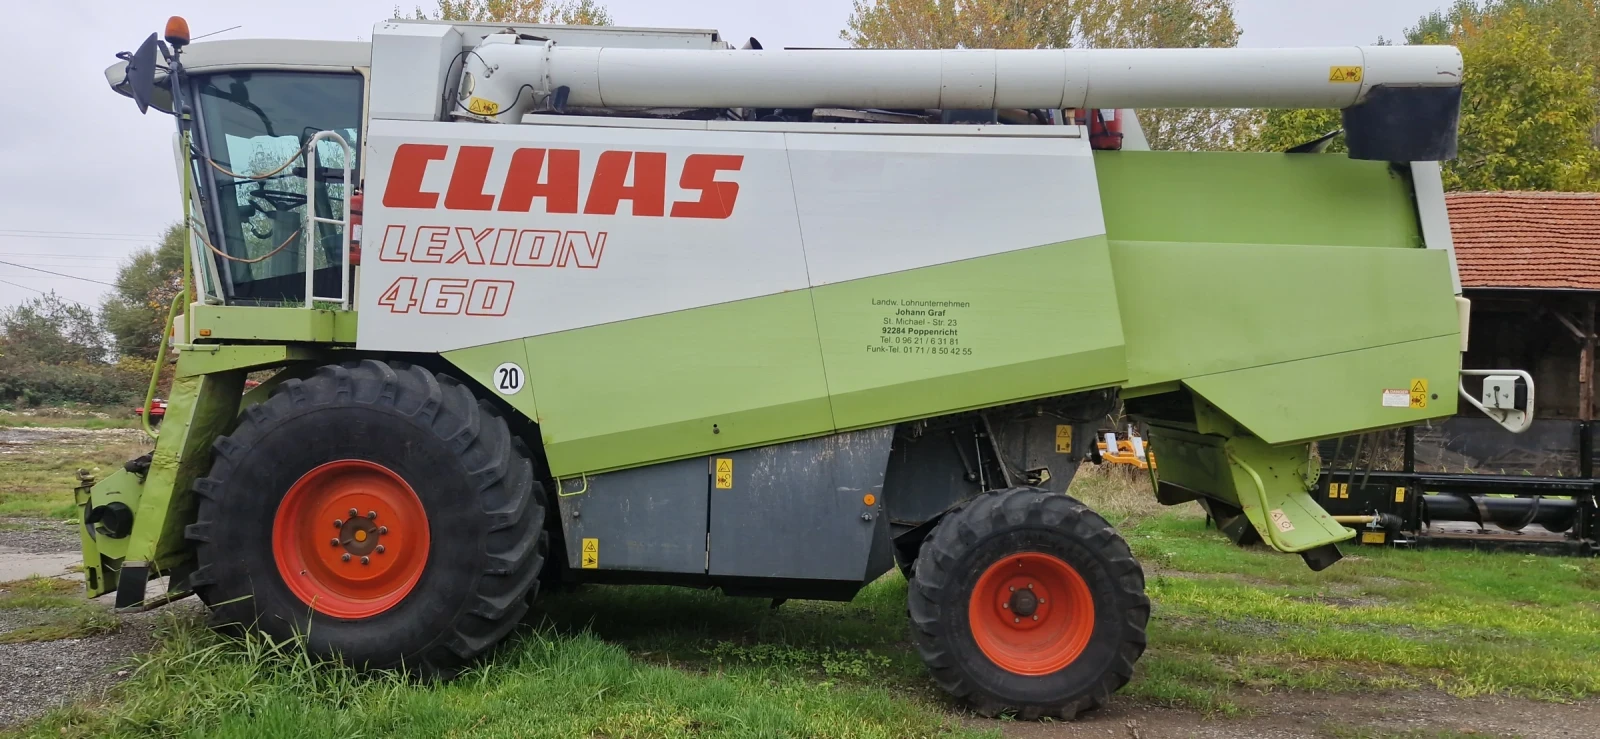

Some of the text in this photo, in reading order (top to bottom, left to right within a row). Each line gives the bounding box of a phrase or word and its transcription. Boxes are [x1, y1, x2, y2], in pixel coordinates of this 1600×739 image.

[382, 143, 744, 219] CLAAS
[378, 224, 608, 269] LEXION
[377, 276, 515, 317] 460
[871, 298, 970, 308] Landw. Lohnunternehmen
[895, 308, 946, 317] Johann Graf
[883, 317, 893, 325] St.
[895, 318, 926, 326] Michael
[932, 319, 945, 327] Str.
[947, 319, 958, 327] 23
[881, 326, 958, 336] 92284 Poppenricht
[880, 335, 893, 344] Tel.
[895, 336, 901, 344] 0
[902, 336, 912, 345] 96
[914, 337, 923, 345] 21
[930, 337, 936, 345] 6
[937, 337, 947, 346] 31
[949, 338, 959, 346] 81
[866, 344, 900, 354] Funk-Tel.
[903, 345, 913, 354] 01
[915, 346, 924, 354] 71
[931, 346, 937, 354] 8
[938, 347, 949, 355] 50
[950, 347, 961, 356] 42
[962, 347, 973, 356] 55
[499, 367, 519, 390] 20
